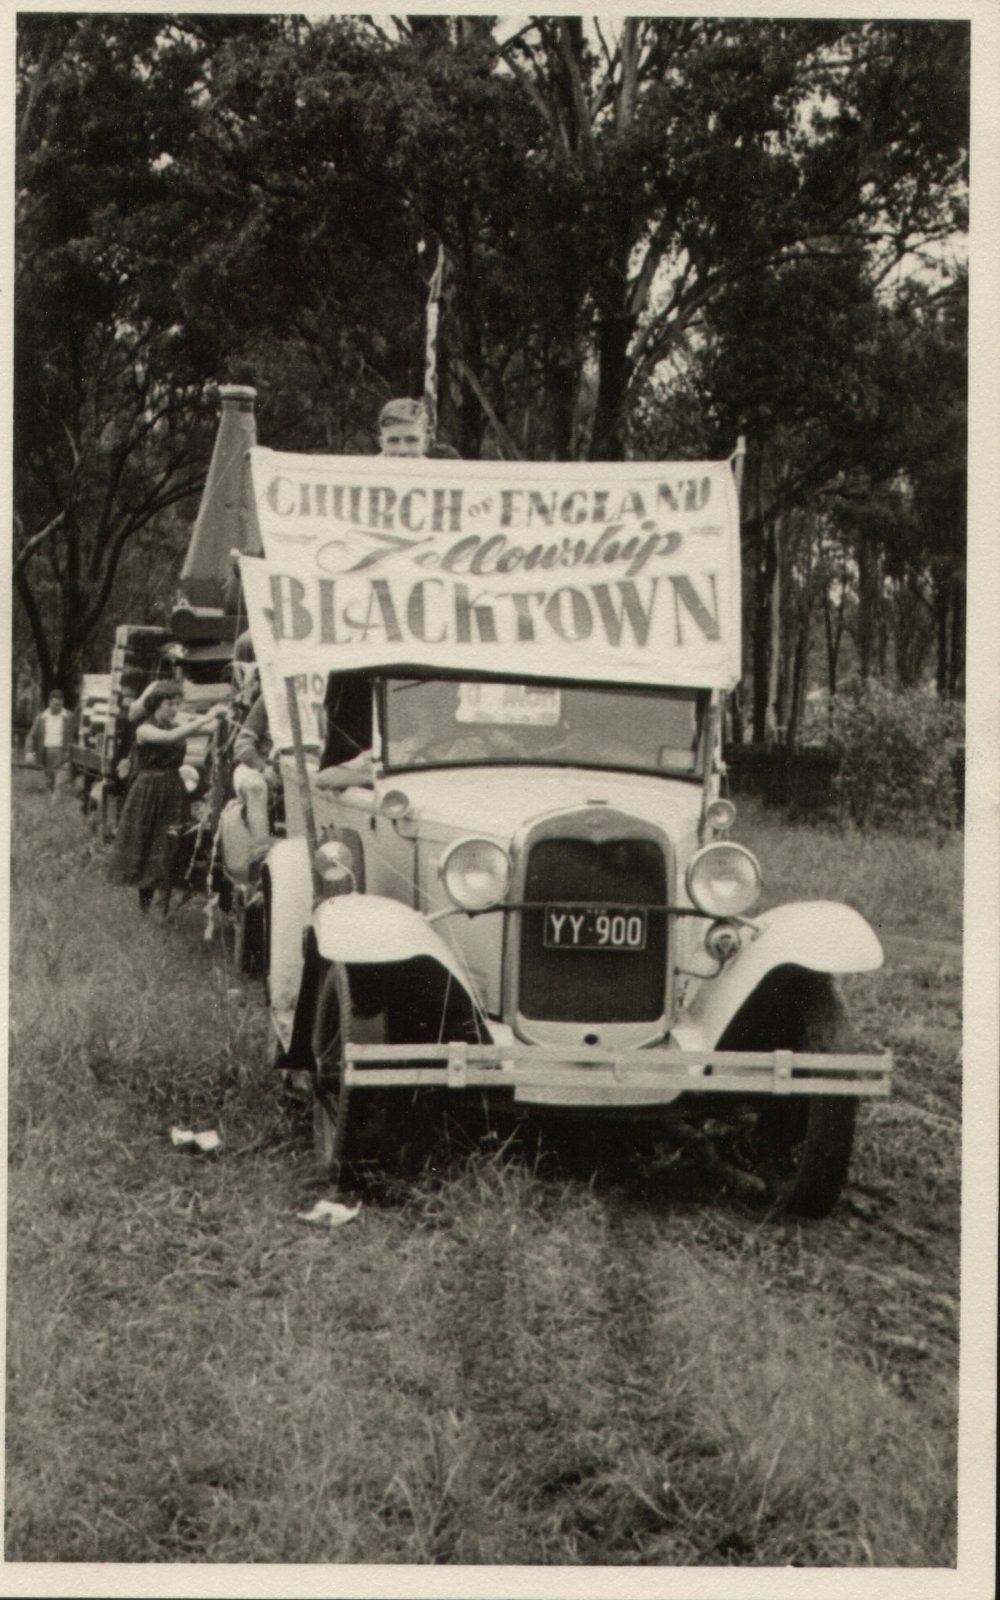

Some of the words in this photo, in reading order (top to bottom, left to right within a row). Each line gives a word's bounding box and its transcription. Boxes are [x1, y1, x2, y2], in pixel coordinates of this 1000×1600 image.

[266, 475, 464, 533] CHURCH
[500, 475, 712, 527] ENGLAND
[315, 519, 683, 577] Fellowship
[263, 573, 722, 647] BLACKTOWN
